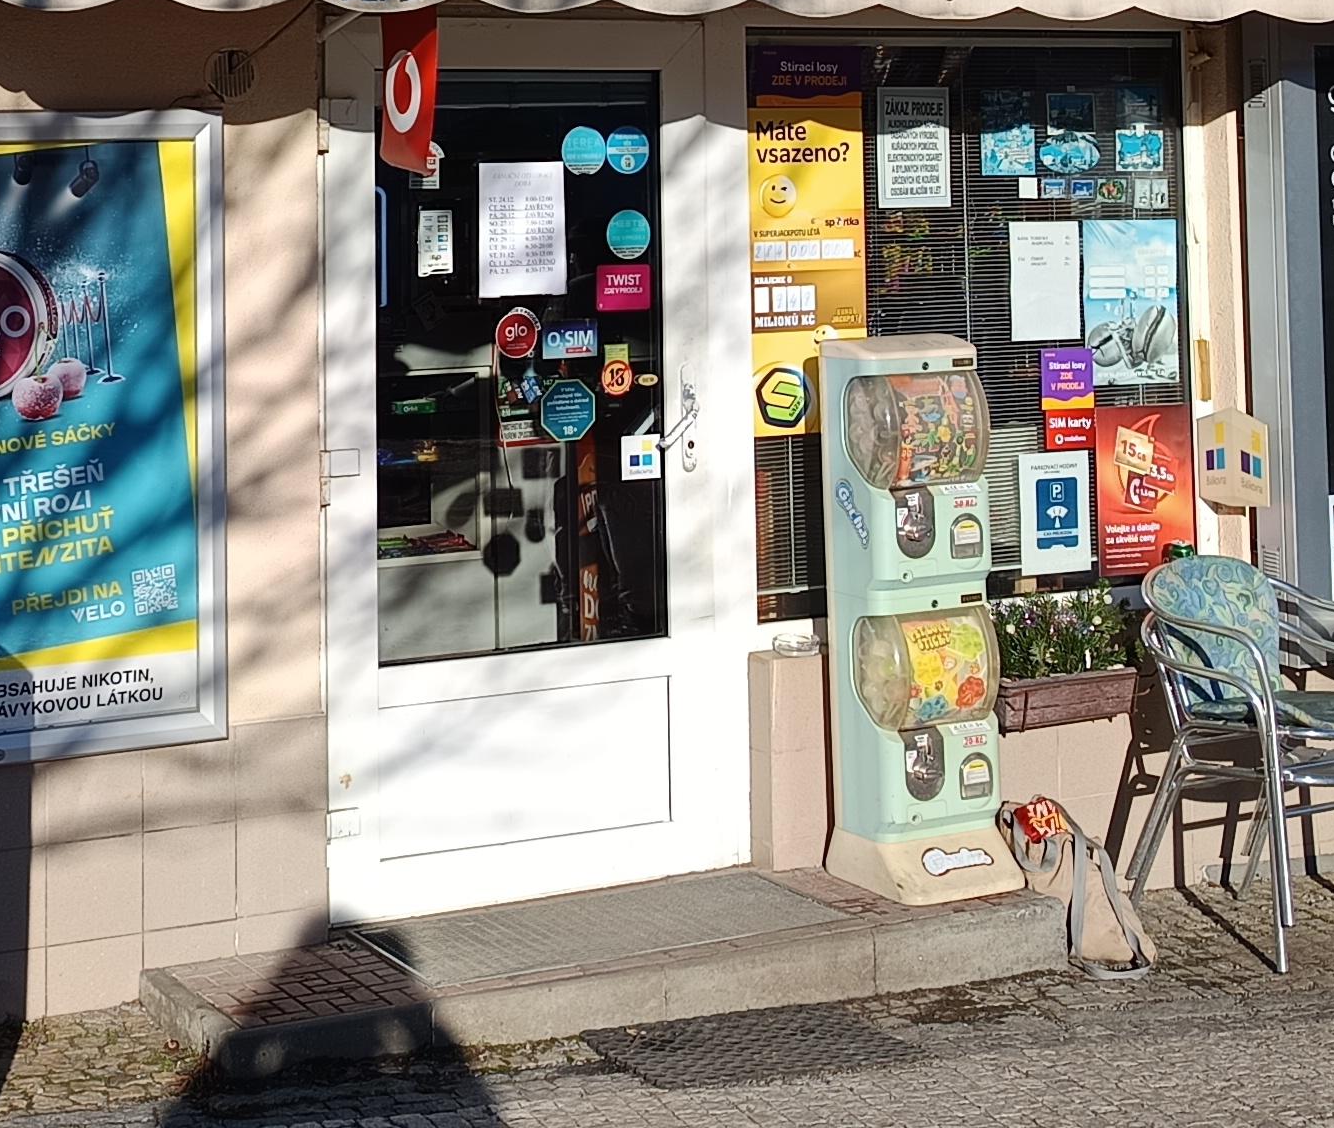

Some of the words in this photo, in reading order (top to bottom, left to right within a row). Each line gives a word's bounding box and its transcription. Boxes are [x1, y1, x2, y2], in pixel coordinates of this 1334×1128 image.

[816, 61, 838, 75] losy
[771, 75, 792, 86] ZDE
[794, 75, 802, 86] V
[805, 75, 847, 87] PRODEJI
[885, 98, 909, 115] ZÁKAZ
[911, 101, 943, 116] PRODEJE
[756, 120, 807, 142] Máte
[756, 142, 850, 164] vsazeno?
[606, 274, 642, 286] TWIST
[755, 312, 799, 328] MILIONŮ
[801, 311, 815, 326] KČ
[505, 323, 528, 342] glo
[564, 329, 595, 346] SIM
[1049, 417, 1067, 429] SIM
[1068, 417, 1092, 429] karty
[50, 422, 116, 446] SÁČKY
[1121, 440, 1136, 458] 15
[3, 459, 104, 500] TŘEŠEŇ
[33, 489, 92, 515] ROLI
[3, 507, 115, 548] PŘÍCHUŤ
[1105, 524, 1130, 534] Volejte
[1105, 536, 1115, 544] za
[12, 589, 89, 616] PŘEJDI
[93, 580, 123, 601] NA
[71, 600, 126, 624] VELO
[82, 668, 155, 688] NIKOTIN,
[96, 686, 164, 709] LÁTKOU
